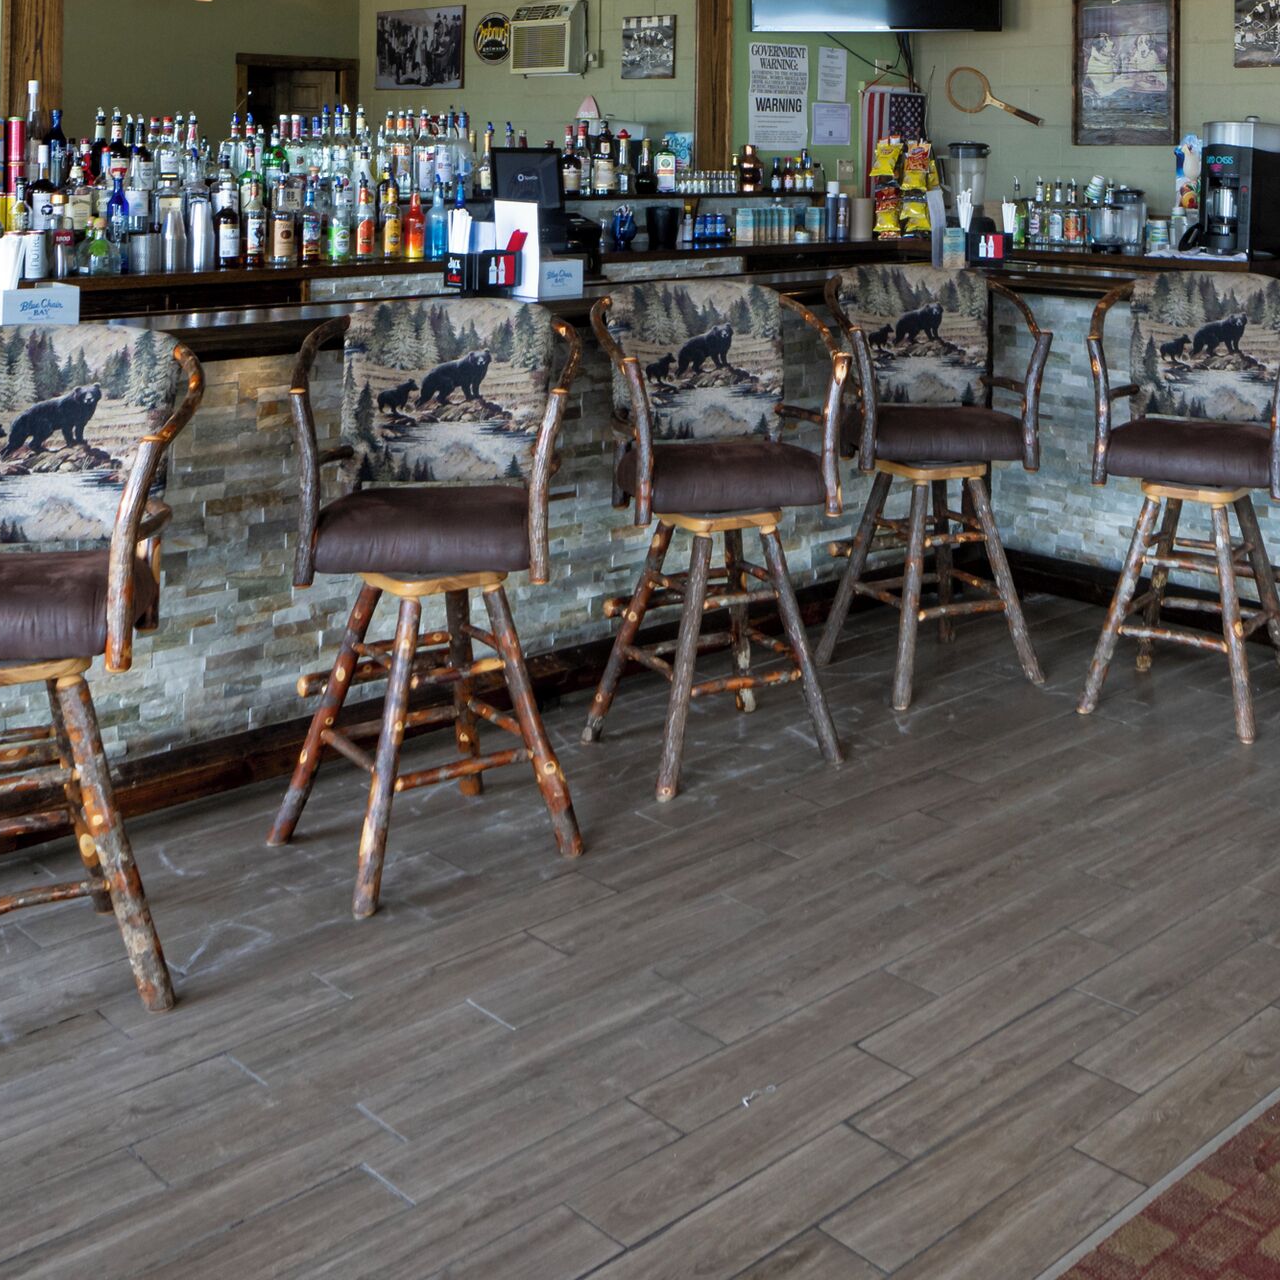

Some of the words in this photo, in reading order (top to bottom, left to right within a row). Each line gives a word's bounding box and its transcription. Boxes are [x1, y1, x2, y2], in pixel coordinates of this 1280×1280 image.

[751, 44, 806, 59] GOVERNMENT
[760, 57, 799, 71] WARNING:
[755, 97, 802, 113] WARNING
[19, 301, 41, 311] Blue
[40, 298, 64, 309] Chair
